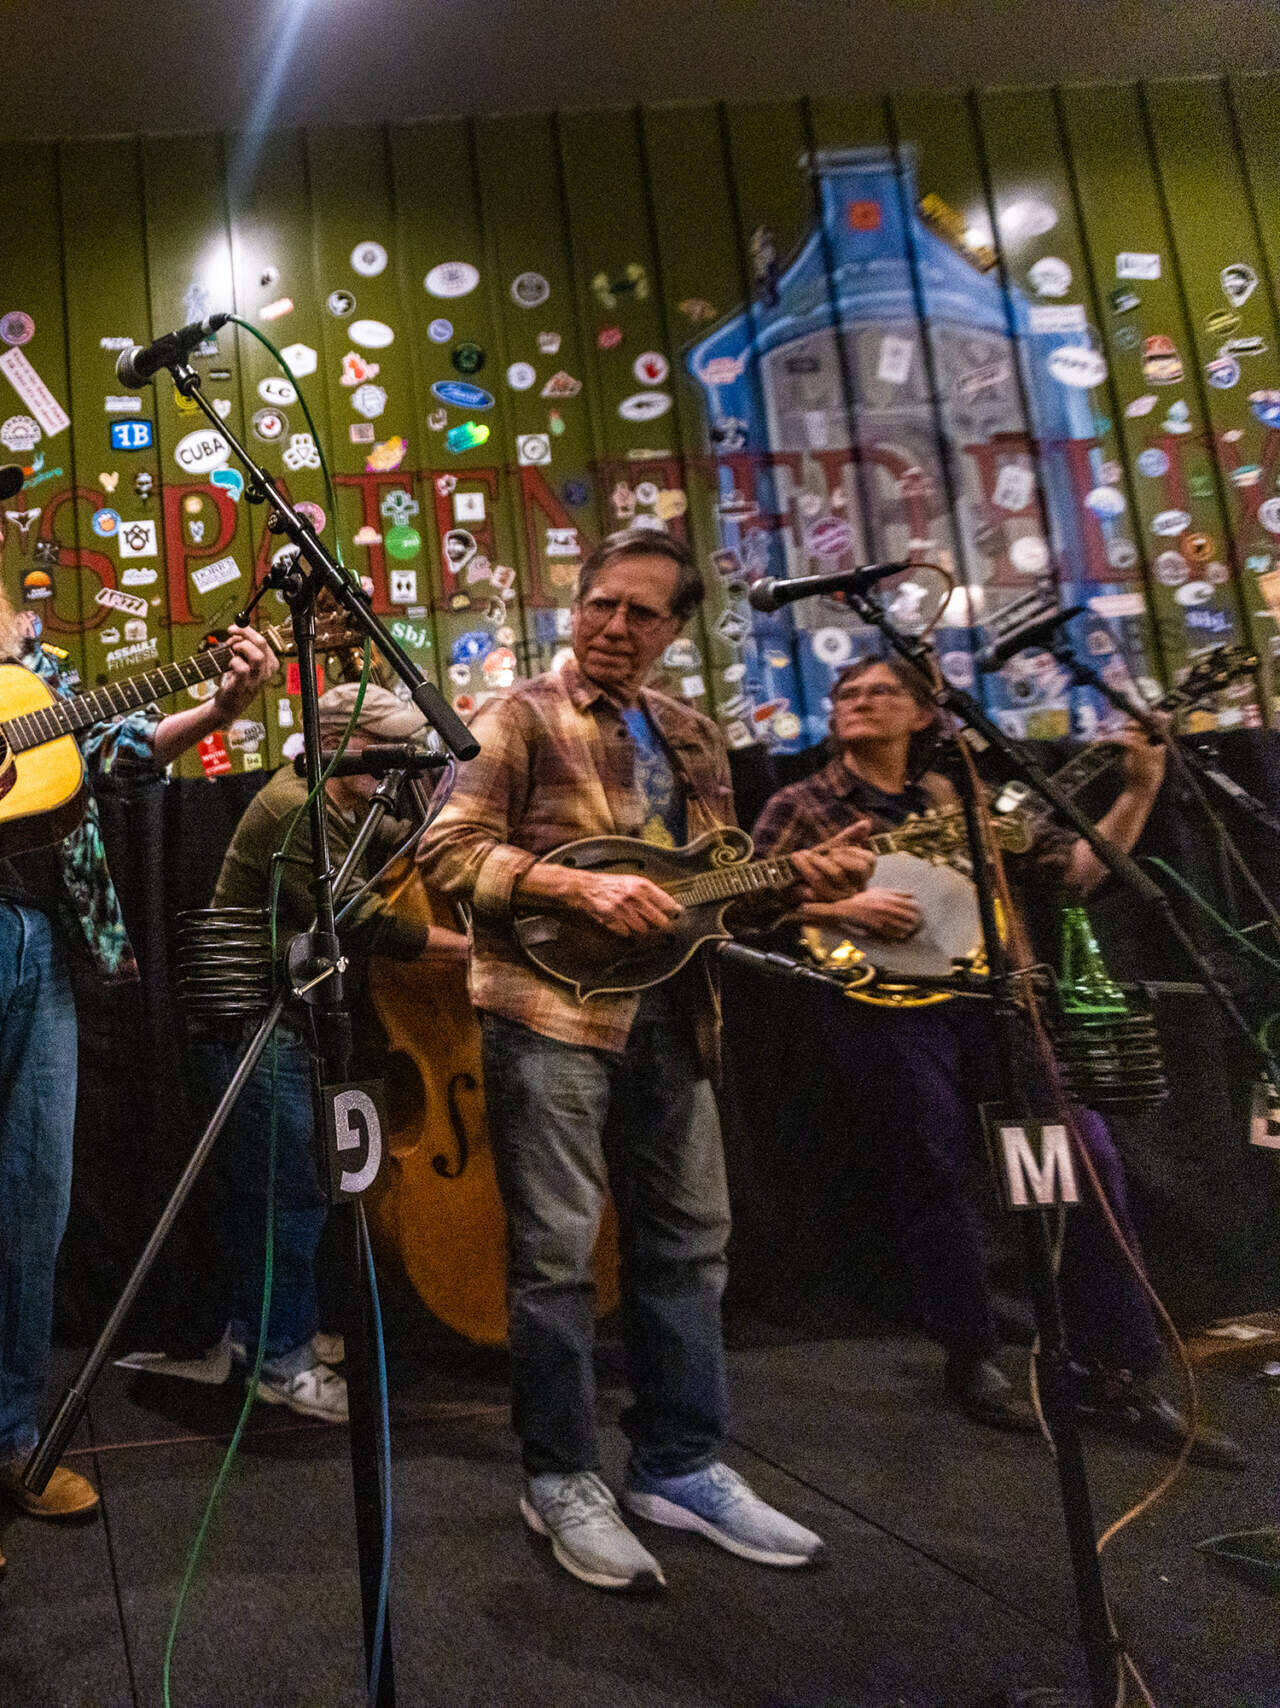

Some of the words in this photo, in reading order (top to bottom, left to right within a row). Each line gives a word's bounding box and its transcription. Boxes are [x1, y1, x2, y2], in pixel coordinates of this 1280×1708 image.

[179, 438, 225, 465] CUBA
[392, 622, 432, 648] Sbj.
[107, 638, 157, 662] ASSAULT
[107, 647, 158, 671] FITNESS
[1000, 1124, 1079, 1205] M
